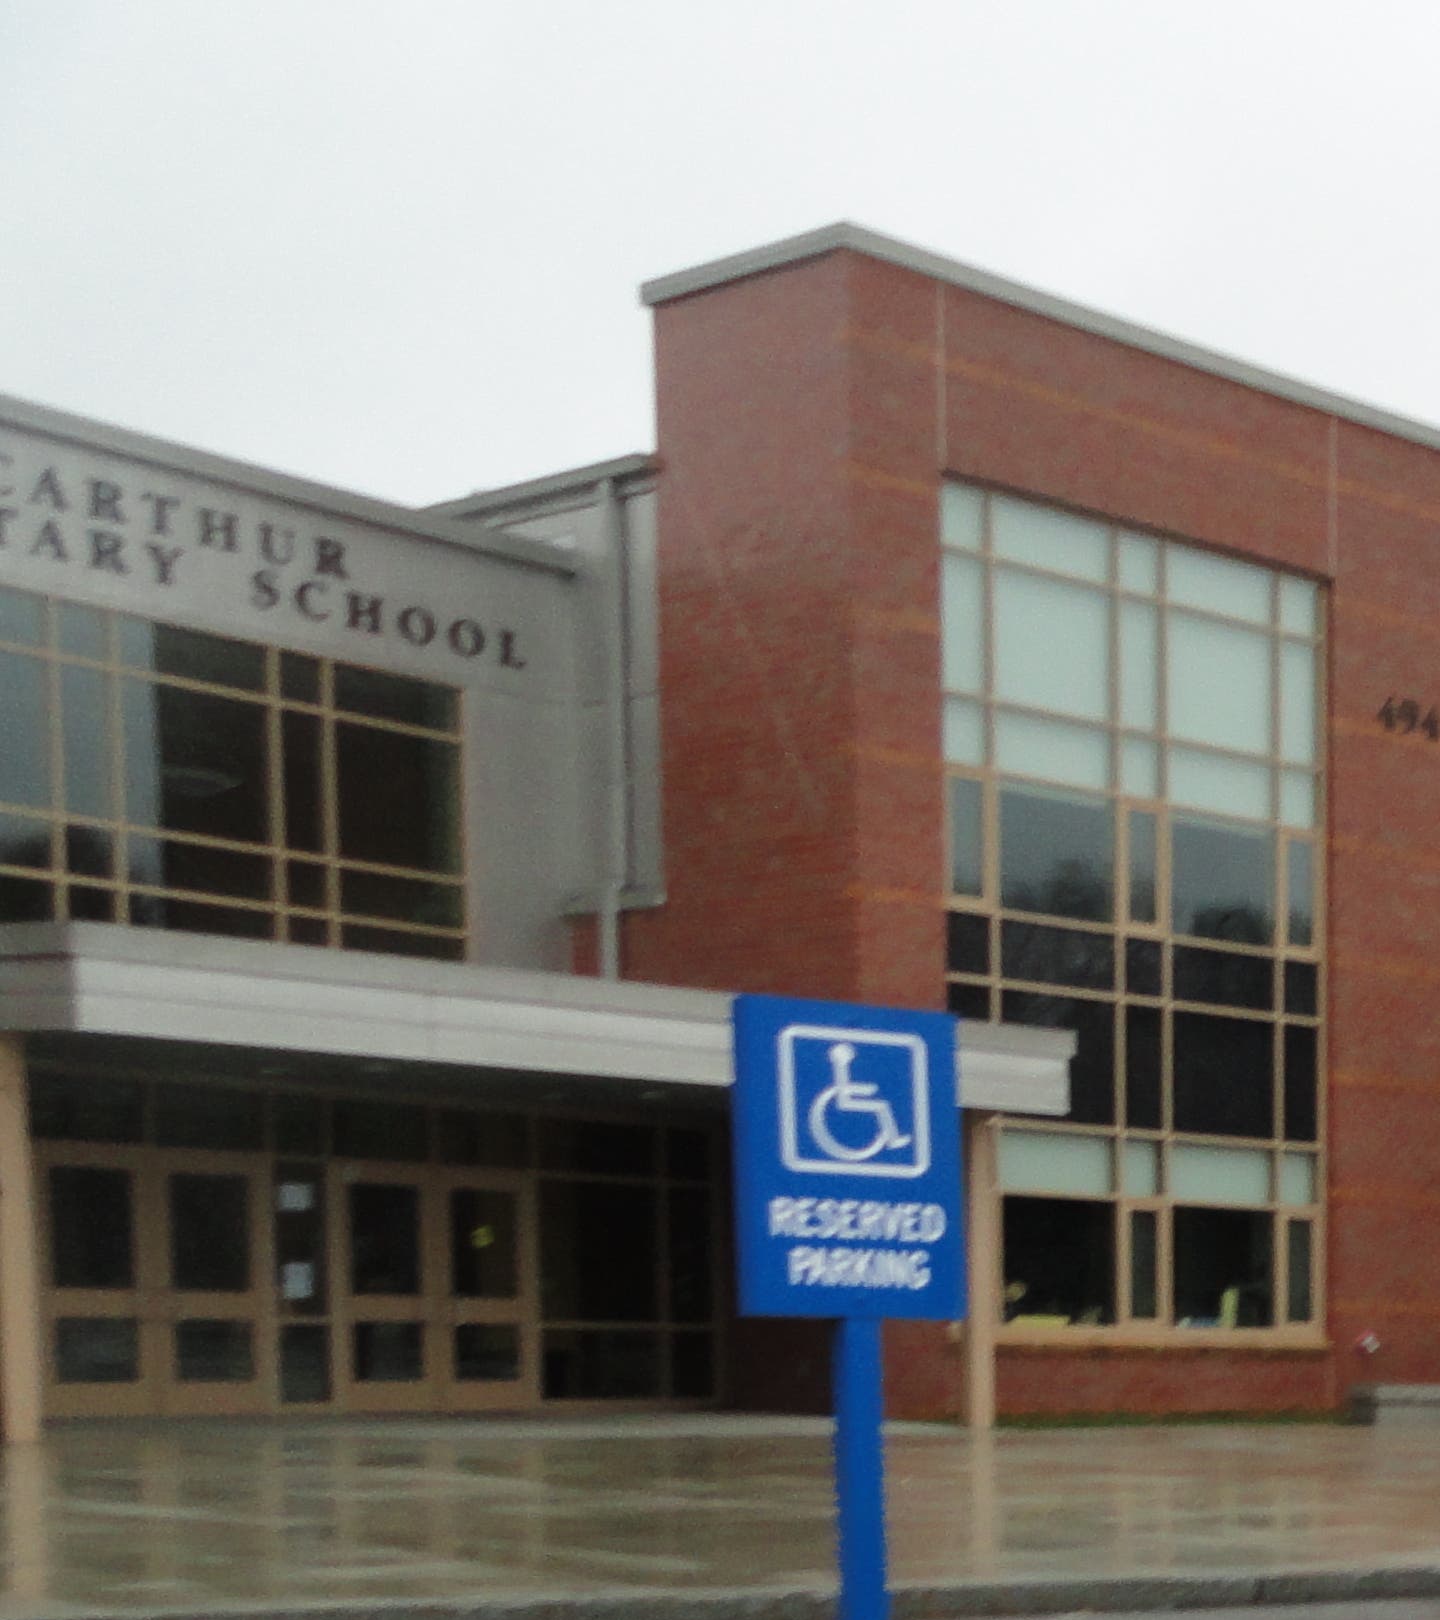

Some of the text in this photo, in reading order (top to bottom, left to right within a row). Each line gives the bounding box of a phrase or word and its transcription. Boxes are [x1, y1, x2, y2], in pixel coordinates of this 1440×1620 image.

[251, 569, 527, 670] SCHOOL
[1377, 696, 1440, 743] 494
[768, 1196, 948, 1243] RESERVED
[787, 1246, 932, 1290] PARKING
